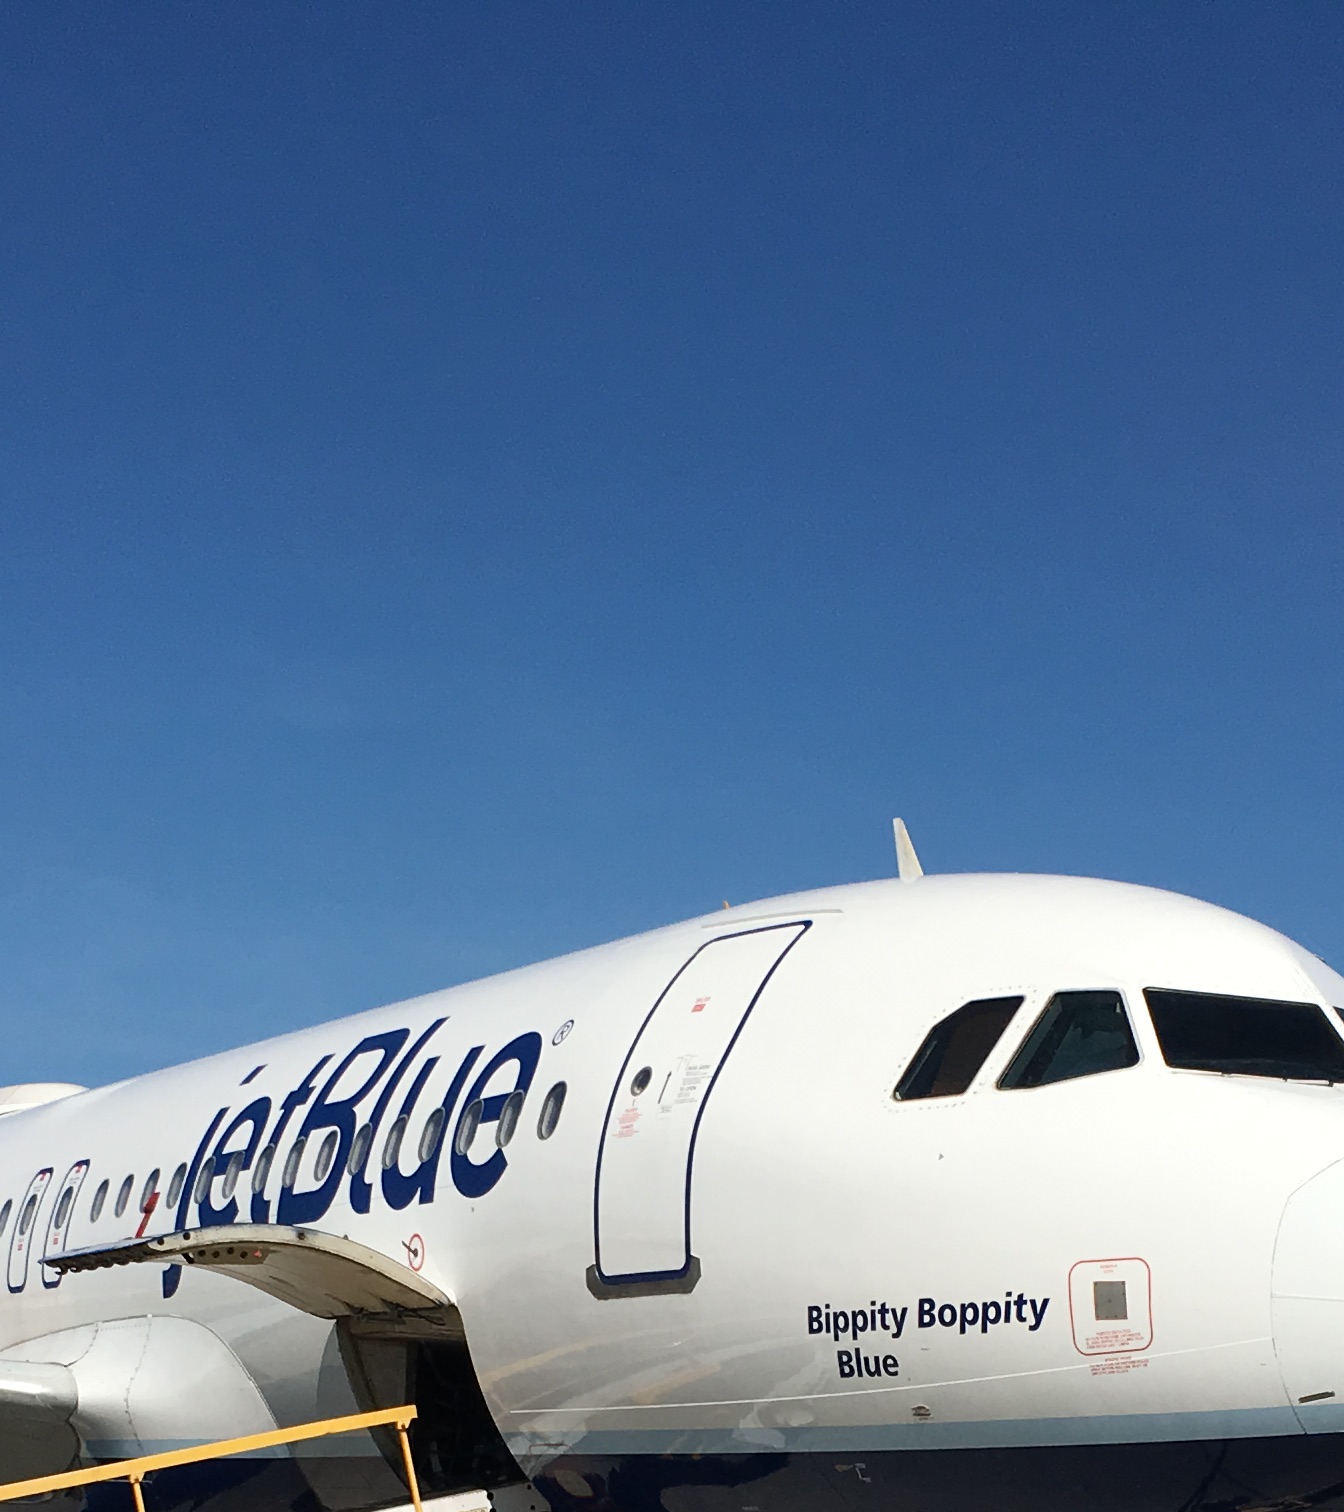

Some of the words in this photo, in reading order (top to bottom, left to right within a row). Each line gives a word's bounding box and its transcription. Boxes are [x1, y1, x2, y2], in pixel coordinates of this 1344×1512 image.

[162, 1016, 544, 1299] jetBlue
[807, 1300, 908, 1342] Bippity
[917, 1291, 1051, 1335] Boppity
[836, 1347, 900, 1378] Blue
